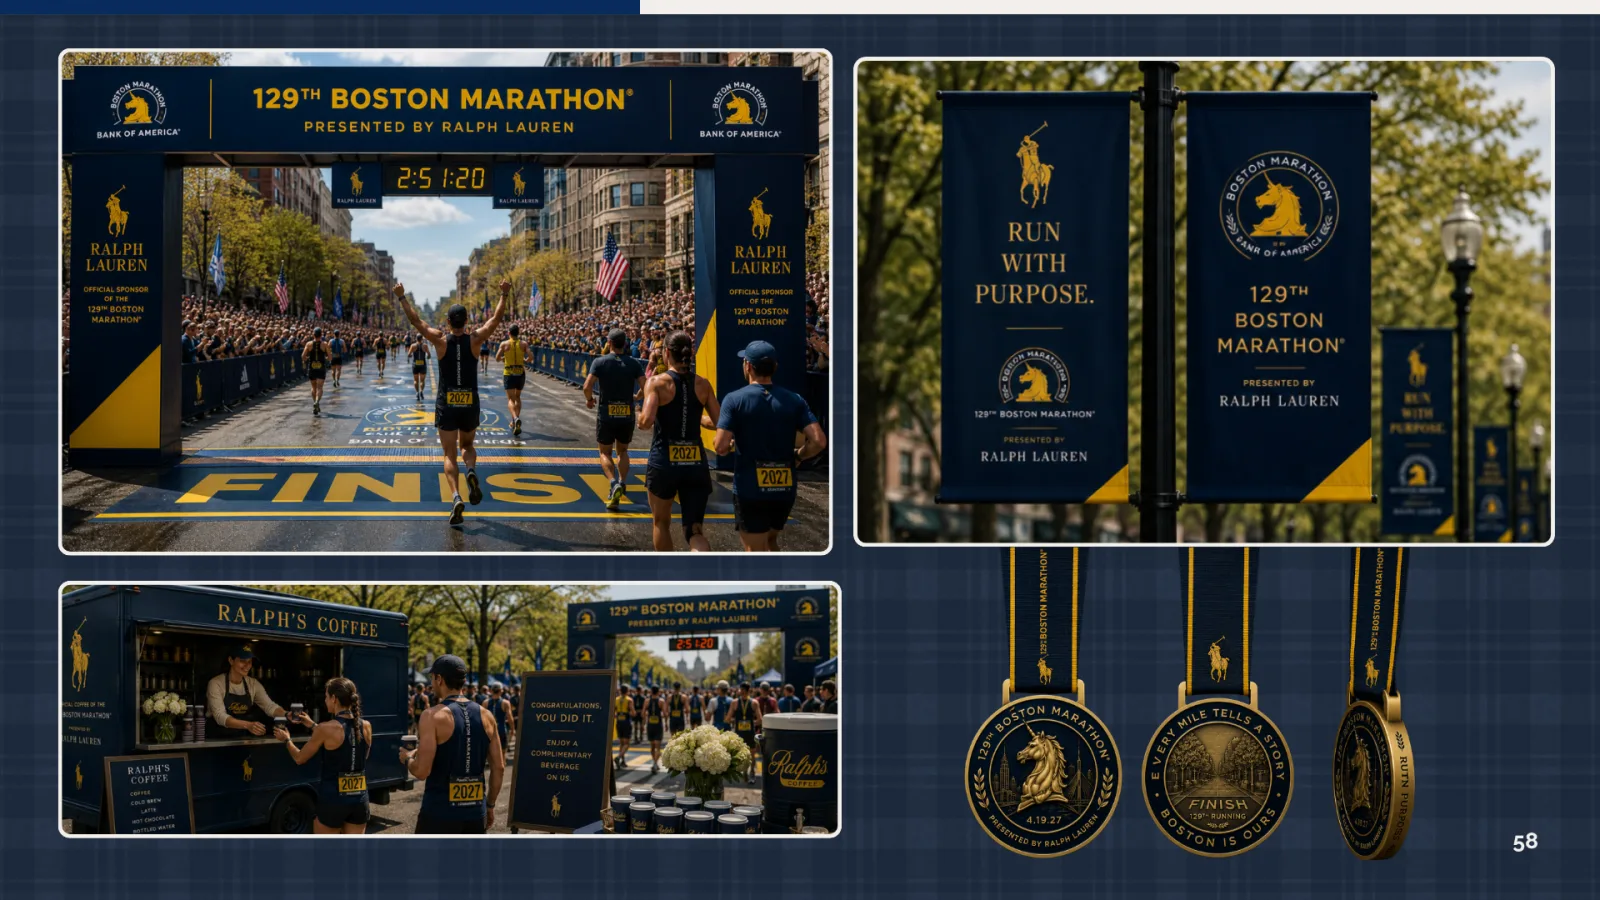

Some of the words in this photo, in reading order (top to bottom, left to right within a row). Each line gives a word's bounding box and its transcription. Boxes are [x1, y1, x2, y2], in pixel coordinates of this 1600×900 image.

[110, 84, 131, 108] BOSTON
[132, 81, 166, 107] MARATHON
[253, 88, 320, 109] 129TH
[331, 88, 449, 109] BOSTON
[734, 82, 767, 108] MARATHON
[304, 121, 405, 133] PRESENTED
[413, 121, 433, 133] BY
[442, 121, 498, 133] RALPH
[506, 121, 574, 133] LAUREN
[398, 167, 484, 189] 2:51:20
[1226, 160, 1266, 201] BOSTON
[1271, 157, 1333, 200] MARATHON
[1008, 222, 1061, 242] RUN
[90, 242, 143, 256] RALPH
[735, 246, 786, 258] RALPH
[86, 258, 148, 272] LAUREN
[731, 262, 791, 274] LAUREN
[1002, 254, 1066, 272] WITH
[975, 284, 1094, 304] PURPOSE.
[1250, 286, 1308, 303] 129TH
[1236, 313, 1323, 328] BOSTON
[450, 393, 470, 403] 2027
[1220, 395, 1270, 407] RALPH
[1278, 395, 1339, 407] LAUREN
[611, 406, 628, 414] 2027
[1000, 410, 1038, 418] BOSTON
[1402, 408, 1433, 418] WITH
[672, 447, 696, 459] 2027
[981, 451, 1026, 462] RALPH
[1033, 451, 1088, 462] LAUREN
[761, 470, 788, 484] 2027
[641, 602, 694, 615] BOSTON
[1372, 599, 1381, 631] BOSTON
[218, 604, 307, 629] RALPH'S
[317, 616, 378, 637] COFFEE
[536, 713, 556, 722] YOU
[560, 714, 579, 722] DID
[583, 714, 594, 723] IT.
[978, 732, 994, 760] 129TH
[995, 706, 1045, 733] BOSTON
[1178, 710, 1207, 729] MILE
[1213, 708, 1252, 725] TELLS
[1254, 725, 1262, 734] A
[1264, 734, 1285, 780] STORY
[531, 750, 592, 759] COMPLIMENTARY
[128, 764, 170, 775] RALPH'S
[541, 762, 580, 770] BEVERAGE
[768, 750, 828, 780] Ralph's
[131, 774, 168, 784] COFFEE
[342, 778, 363, 790] 2027
[453, 784, 480, 799] 2027
[1189, 799, 1248, 810] FINISH
[144, 814, 174, 823] CHOCOLATE
[1027, 816, 1062, 825] 4.19.27
[989, 815, 1029, 845] PRESENTED
[1031, 840, 1042, 848] BY
[1044, 836, 1071, 847] RALPH
[1073, 814, 1099, 840] LAUREN
[1161, 808, 1215, 847] BOSTON
[1224, 836, 1236, 847] IS
[1243, 808, 1276, 839] OURS
